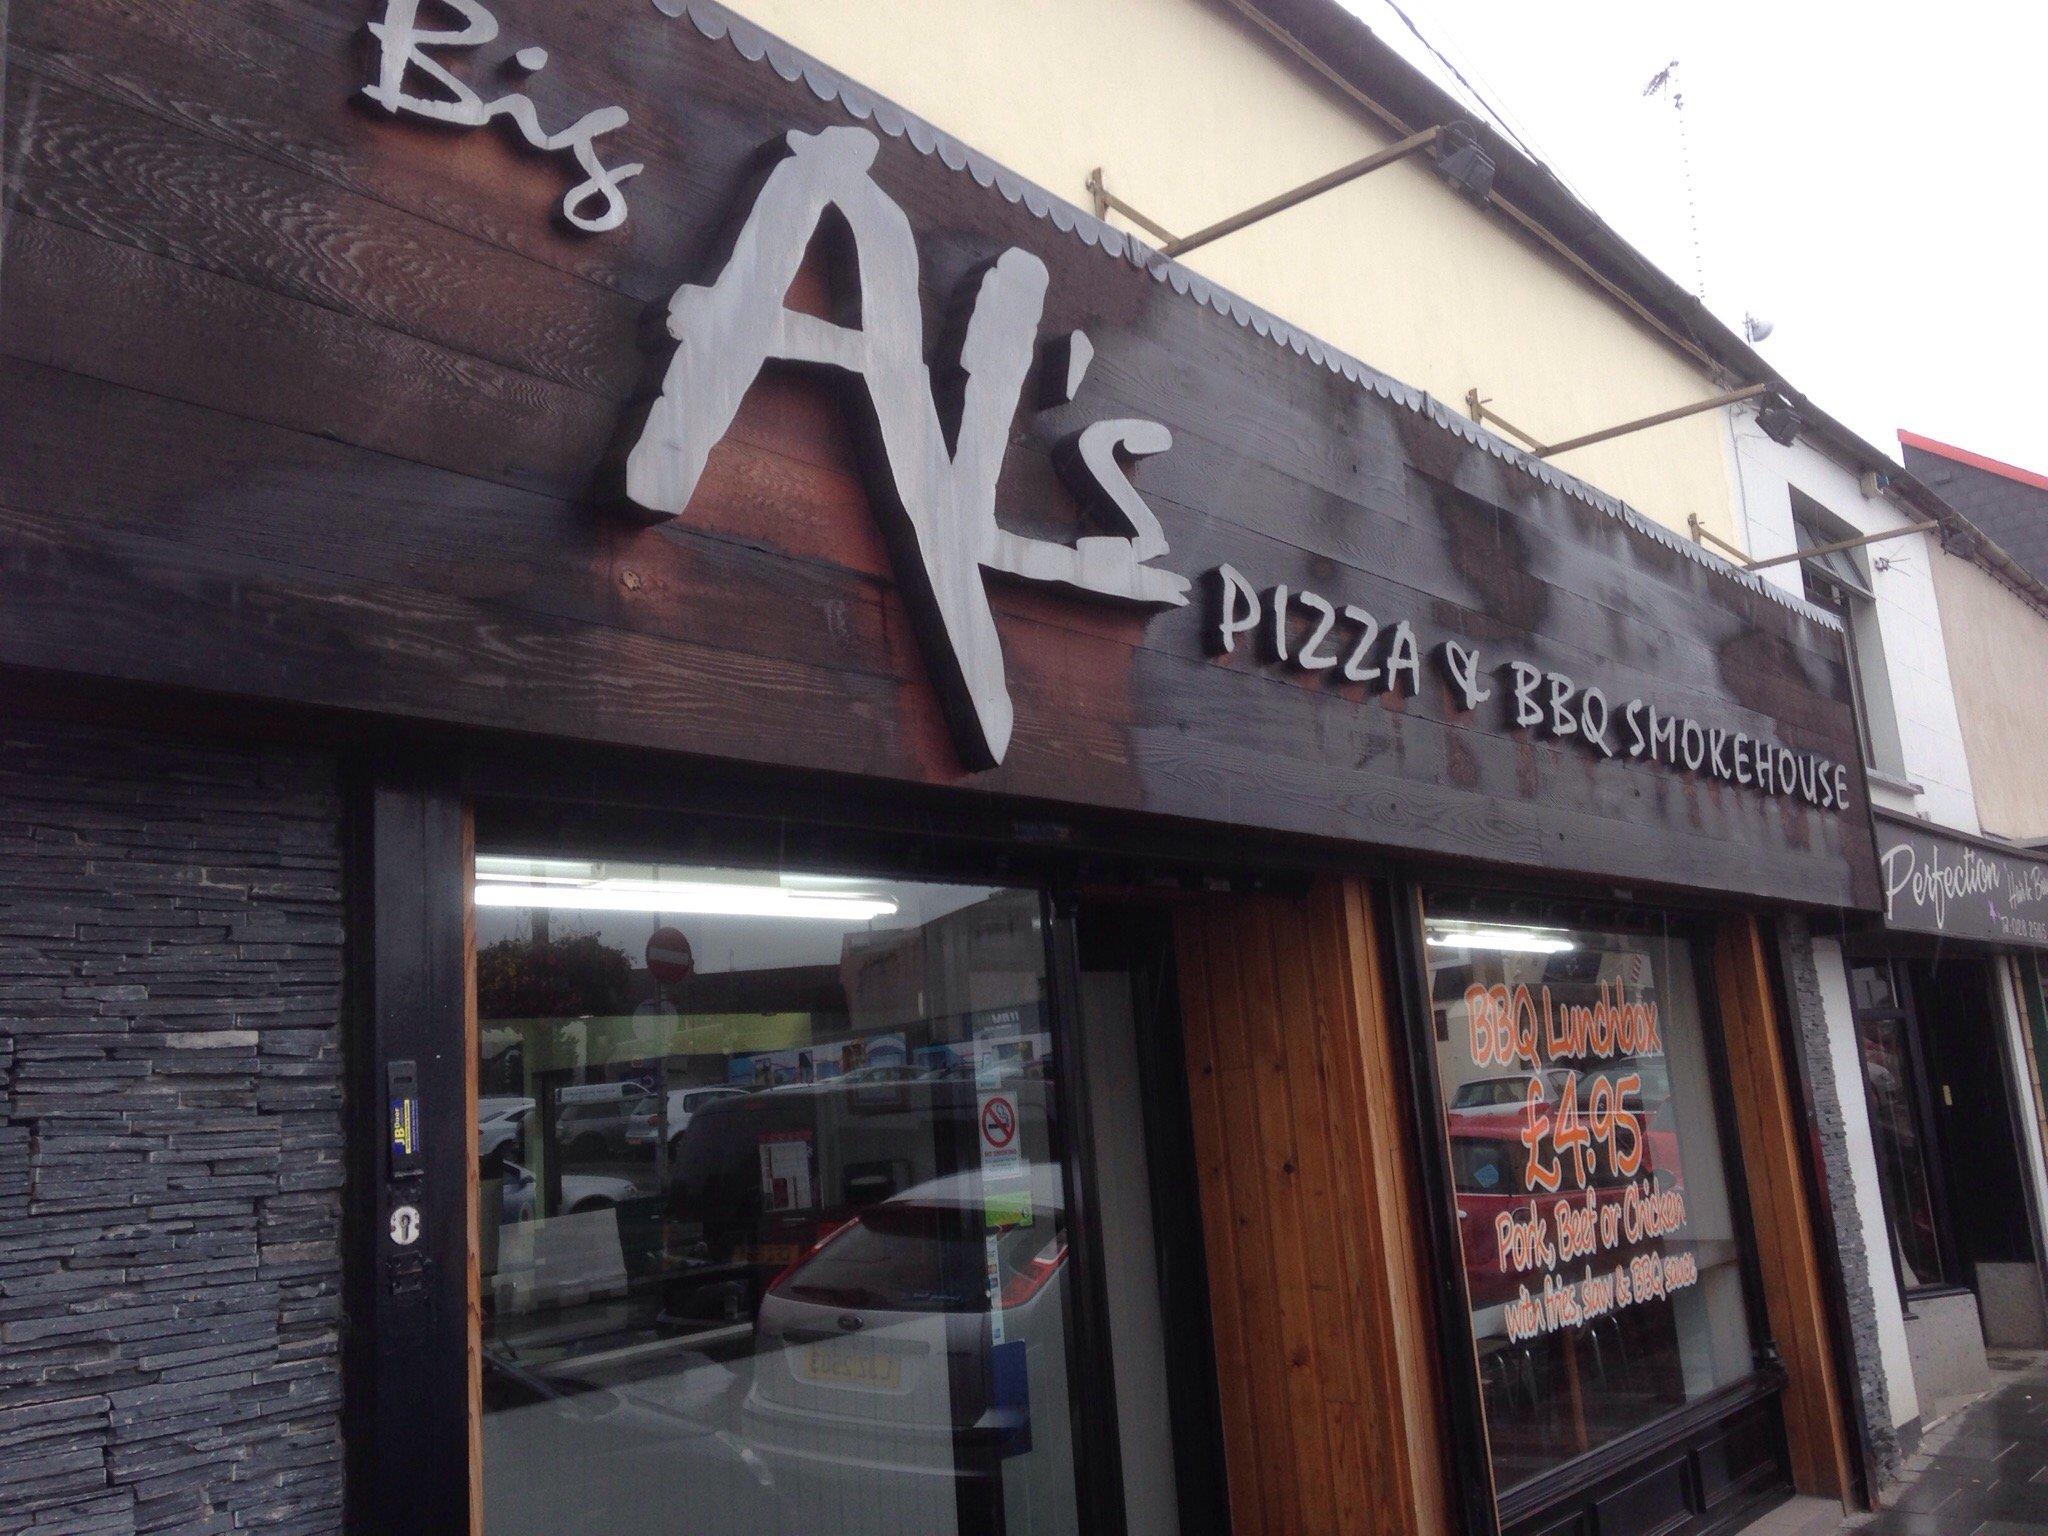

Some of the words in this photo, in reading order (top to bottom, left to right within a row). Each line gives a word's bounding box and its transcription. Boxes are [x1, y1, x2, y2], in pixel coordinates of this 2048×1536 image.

[362, 0, 644, 232] Big
[1218, 563, 1420, 696] PIZZA
[1446, 640, 1490, 710] &
[1509, 660, 1612, 758] BBQ
[1624, 698, 1850, 811] SMOKEHOUSE
[1881, 843, 2000, 930] Perfection
[1464, 982, 1542, 1075] BBQ
[1542, 975, 1662, 1061] Lunchbox
[394, 1127, 406, 1146] JB
[1521, 1070, 1643, 1192] £4.95
[1495, 1199, 1557, 1273] Pork,
[1554, 1185, 1598, 1262] Beef
[1600, 1202, 1621, 1249] or
[1624, 1177, 1687, 1245] Chicken
[1504, 1283, 1546, 1345] with
[1581, 1264, 1614, 1320] slaw
[1615, 1264, 1633, 1308] &
[1630, 1251, 1666, 1305] BBQ
